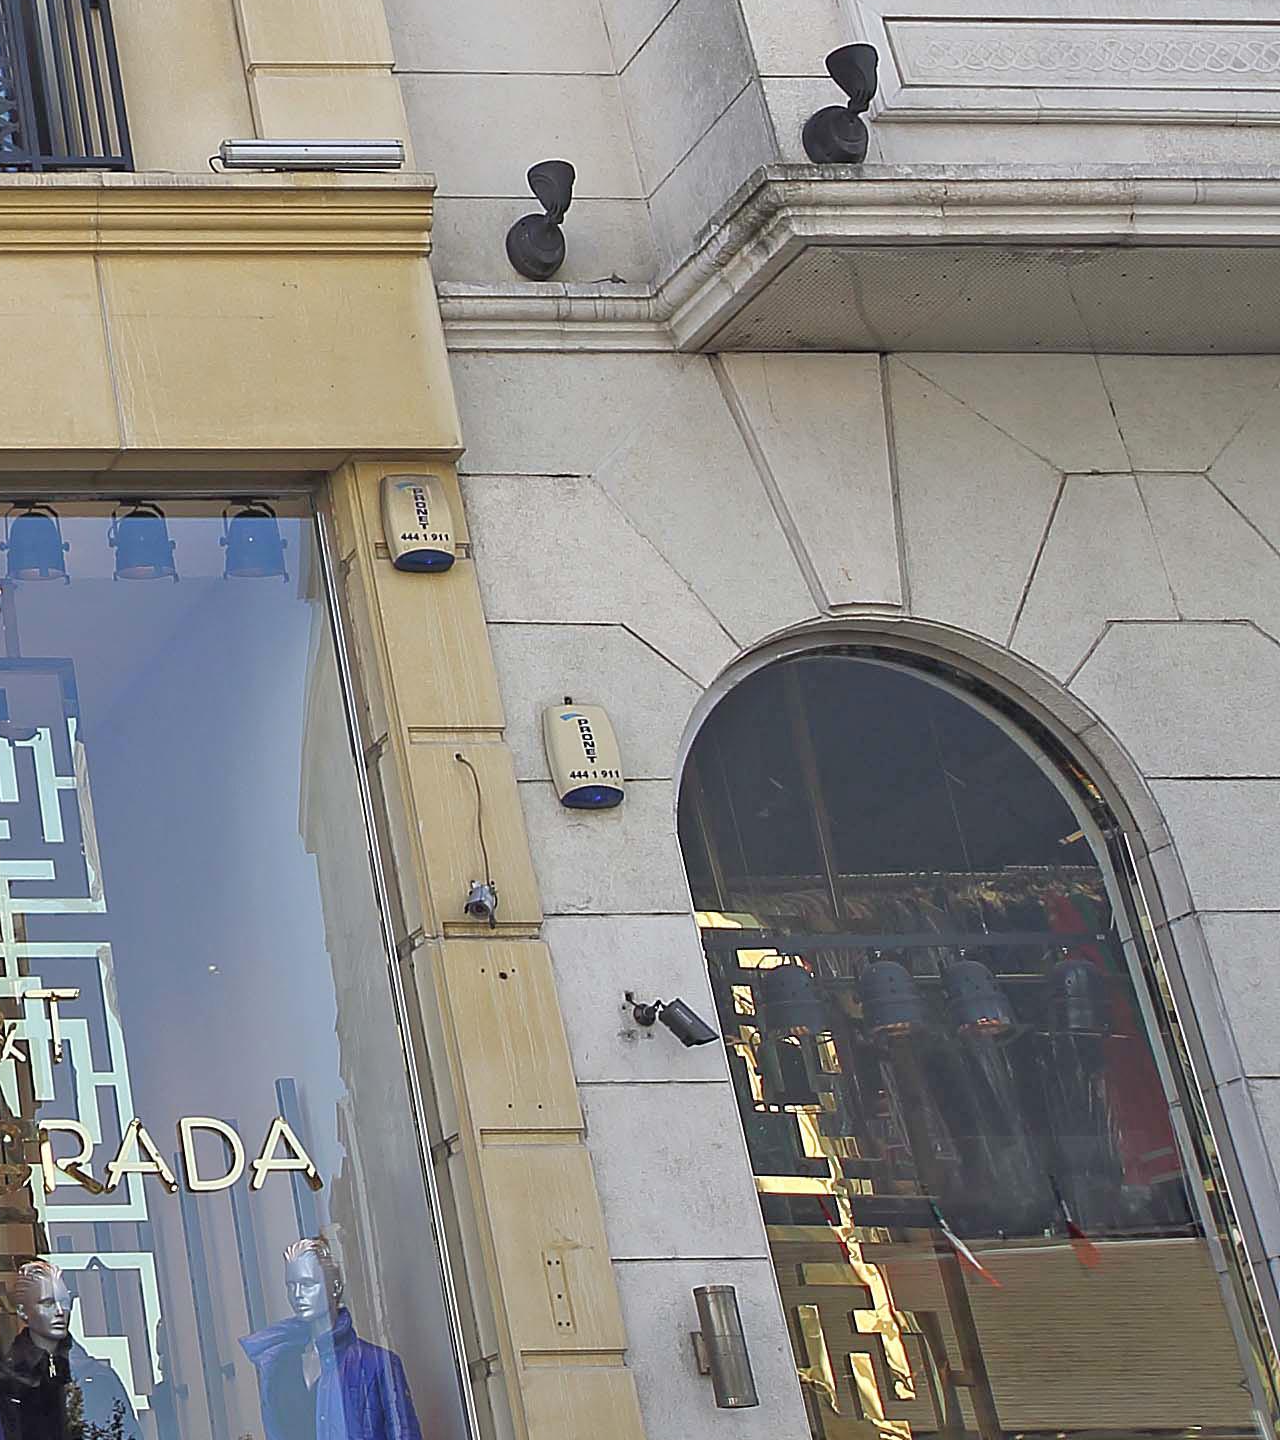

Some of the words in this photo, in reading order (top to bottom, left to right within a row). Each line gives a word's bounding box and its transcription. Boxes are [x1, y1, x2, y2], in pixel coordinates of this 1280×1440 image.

[400, 532, 420, 541] 444
[577, 718, 598, 764] PRONET
[569, 770, 590, 779] 444
[600, 769, 621, 779] 911
